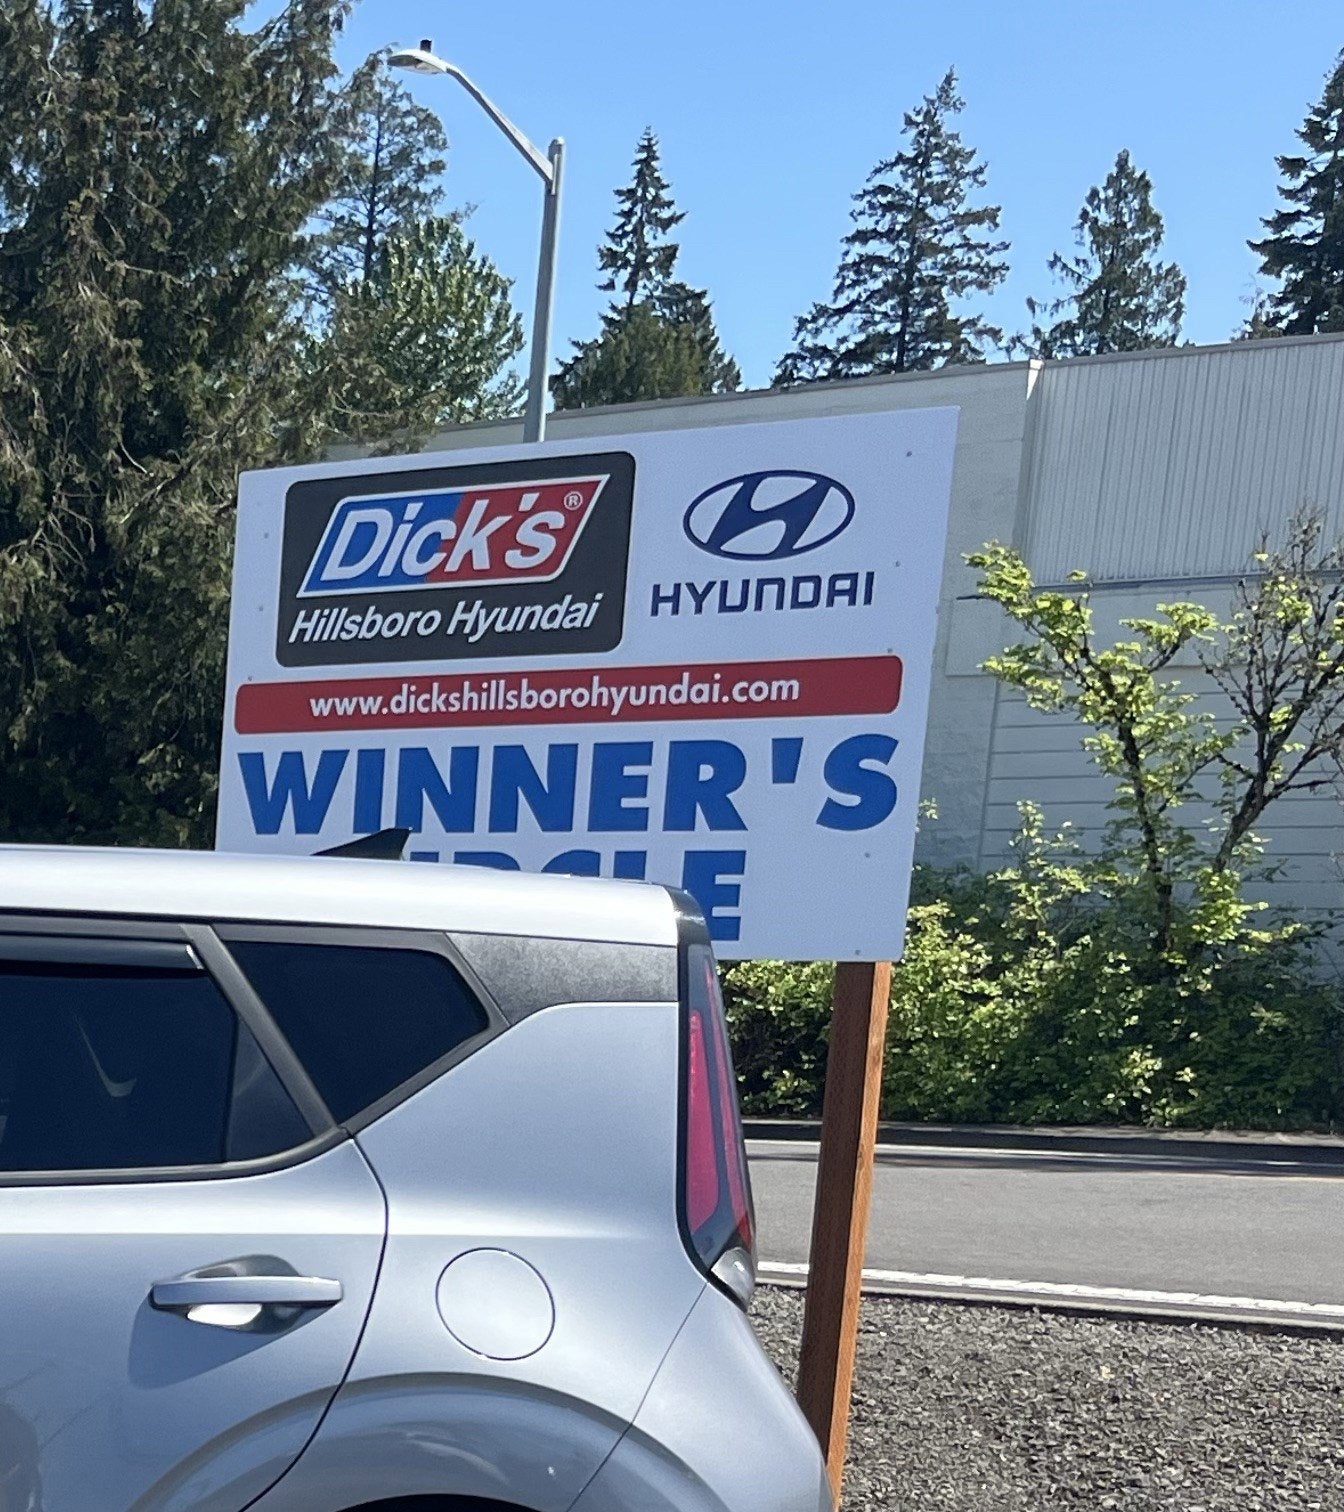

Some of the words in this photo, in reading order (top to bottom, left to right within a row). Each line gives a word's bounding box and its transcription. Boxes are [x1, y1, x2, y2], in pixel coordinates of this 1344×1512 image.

[288, 604, 442, 644] Hillsboro
[446, 592, 604, 643] Hyundai
[650, 571, 875, 617] HYUNDAI
[309, 671, 799, 717] www.dickshillsborohyundai.com
[237, 733, 900, 835] WINNER'S
